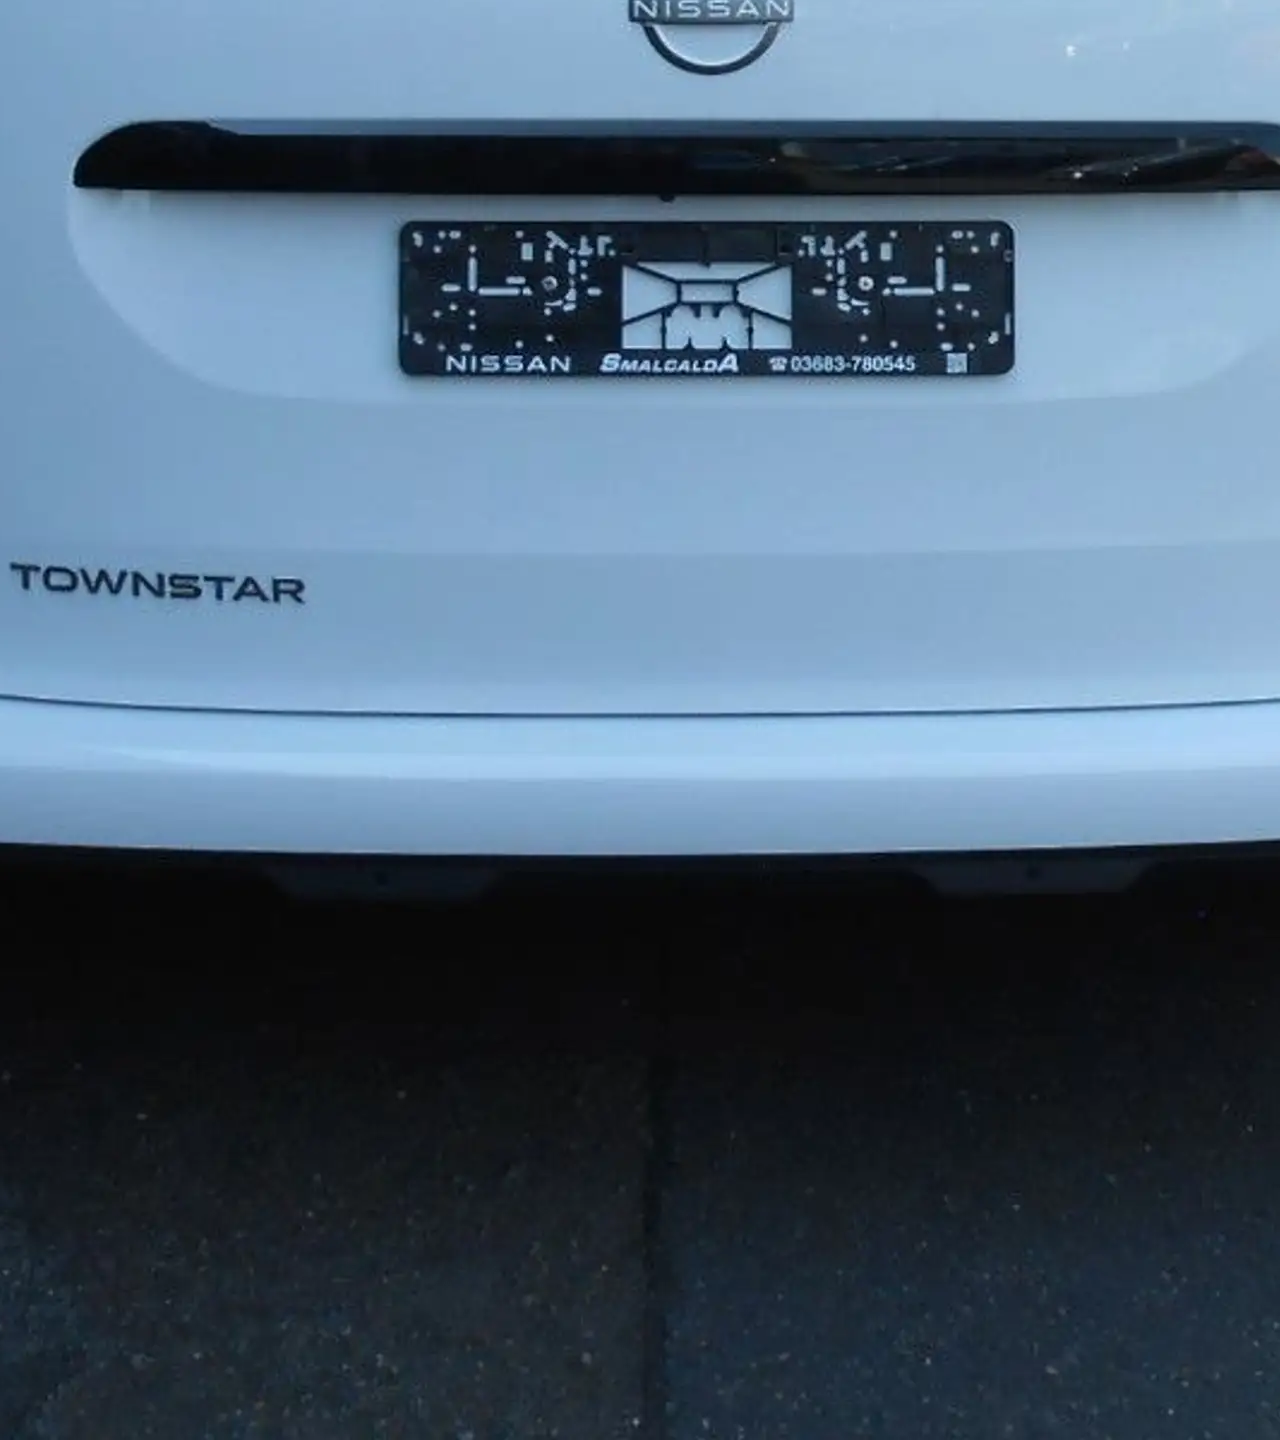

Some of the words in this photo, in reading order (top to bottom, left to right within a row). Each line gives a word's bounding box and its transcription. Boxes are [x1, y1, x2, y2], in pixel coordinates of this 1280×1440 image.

[445, 355, 570, 372] NISSAN
[790, 355, 916, 373] 03683-780545
[10, 561, 306, 604] TOWNSTAR
